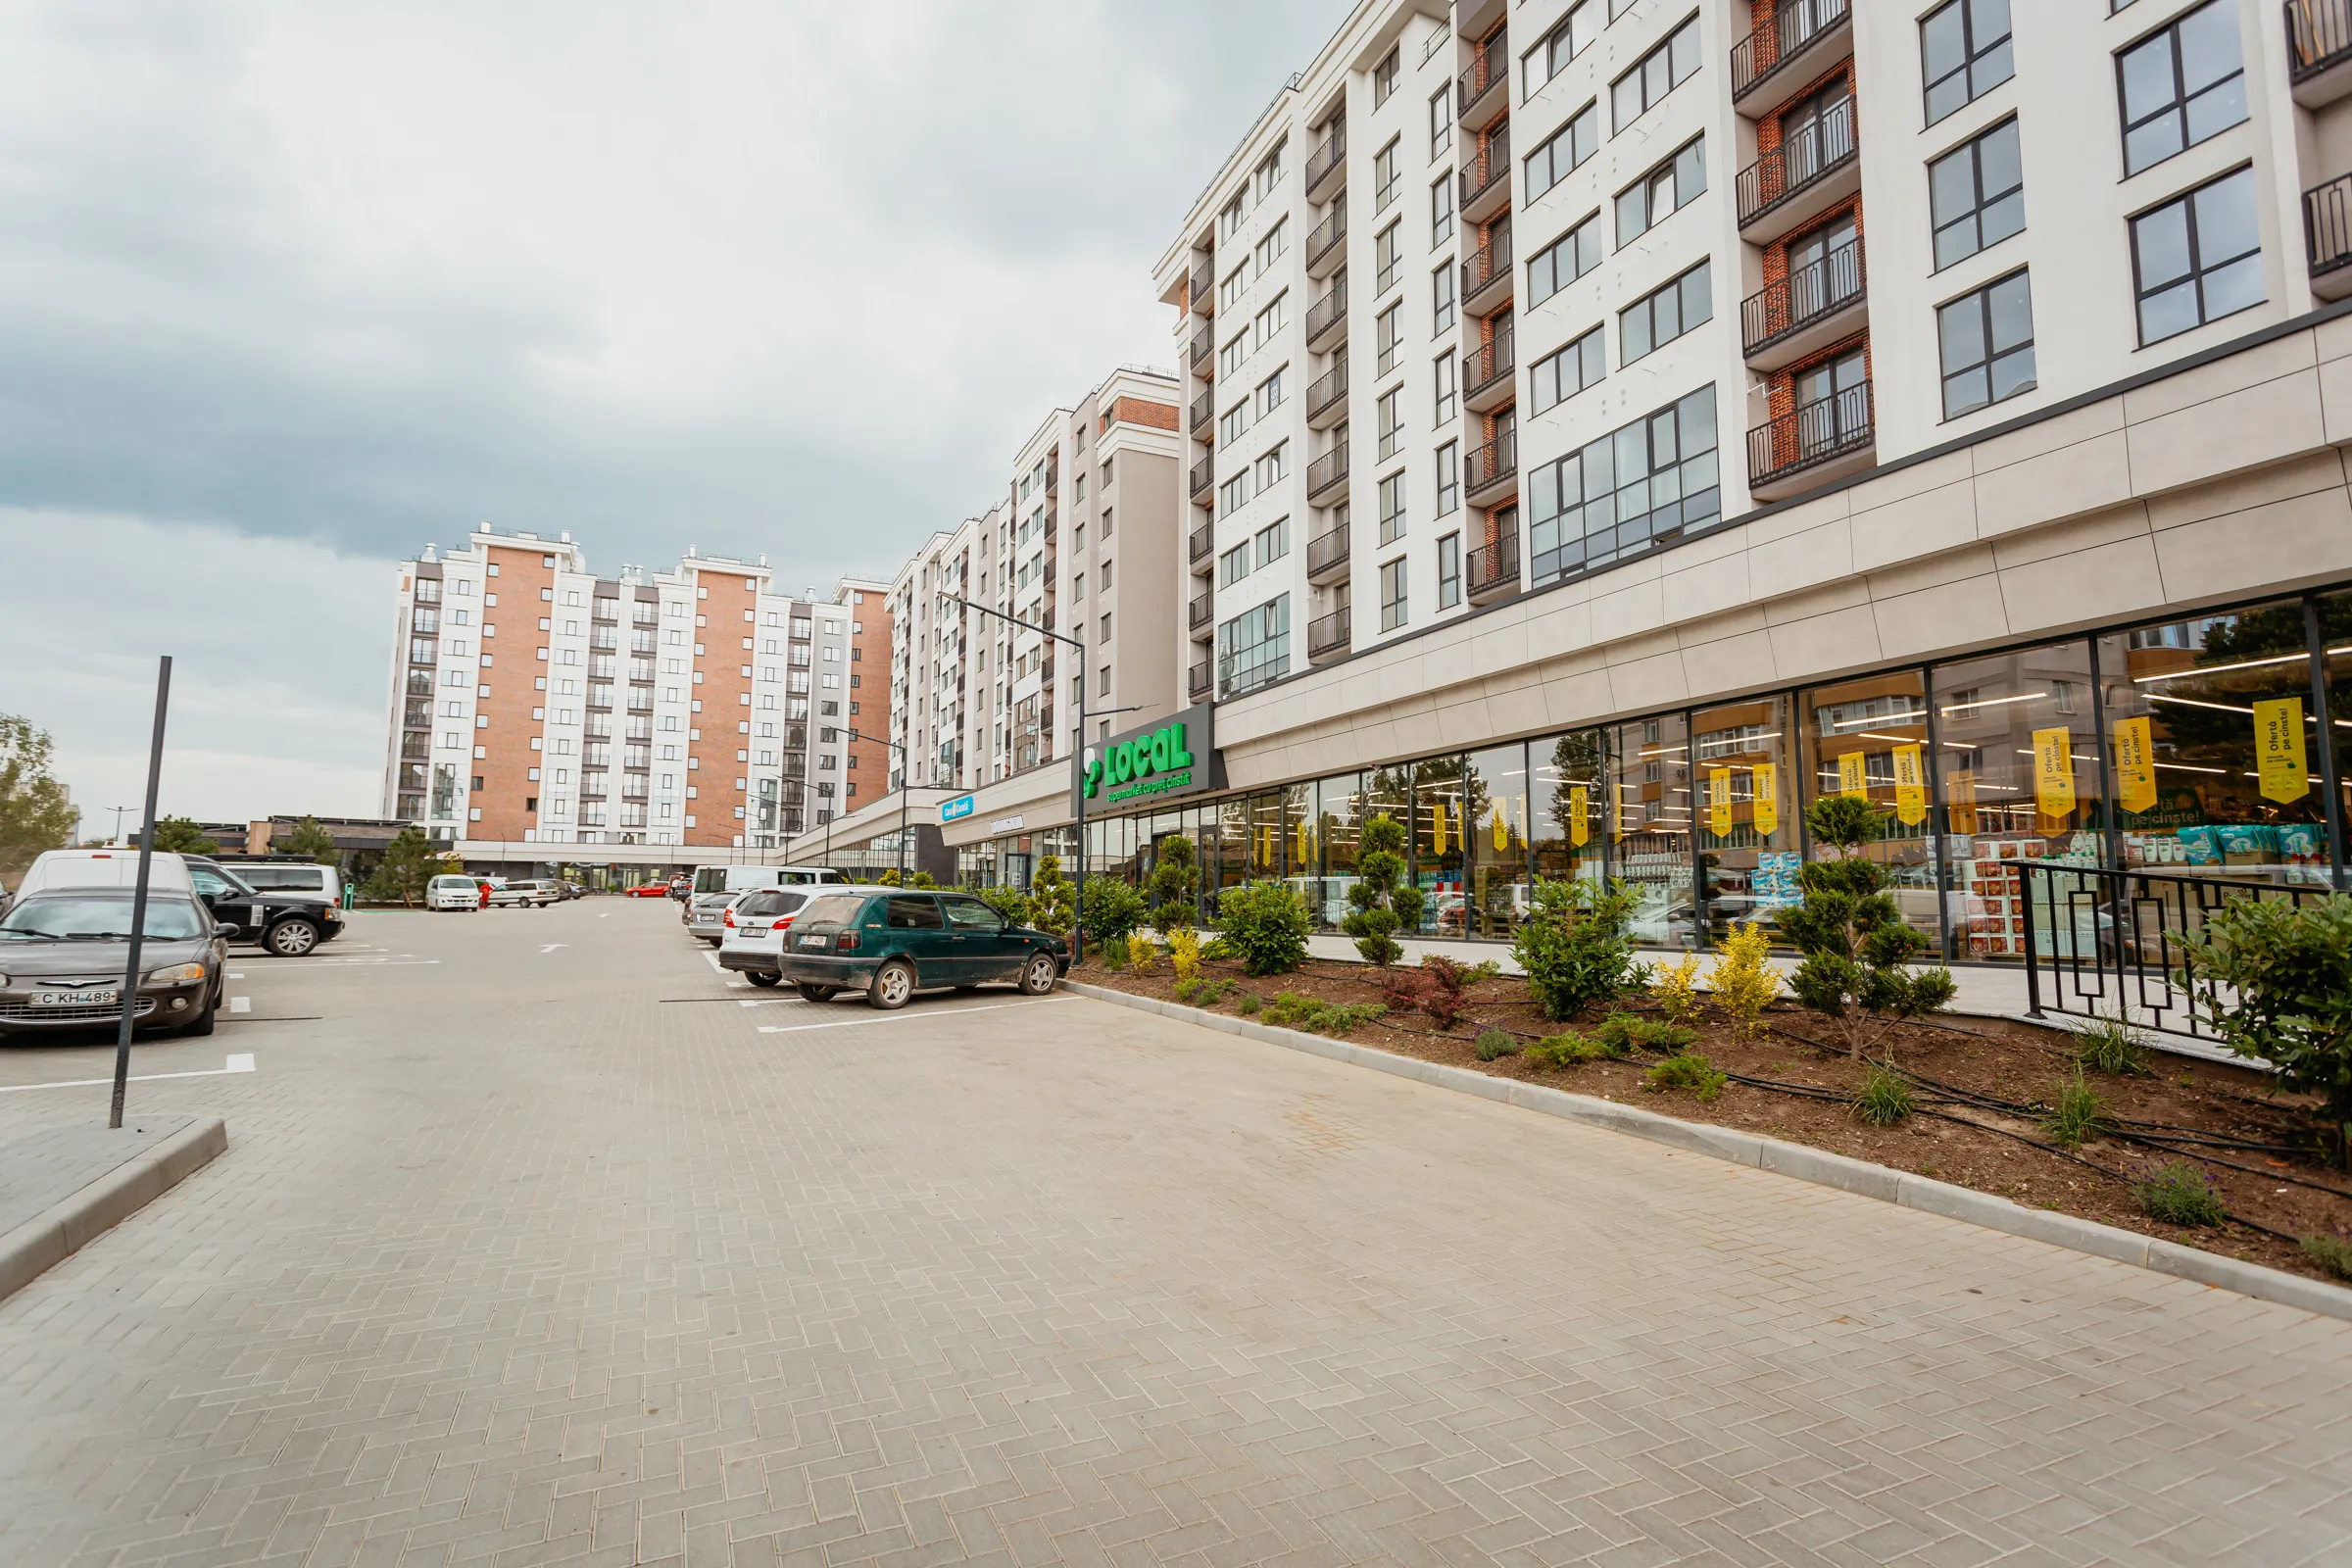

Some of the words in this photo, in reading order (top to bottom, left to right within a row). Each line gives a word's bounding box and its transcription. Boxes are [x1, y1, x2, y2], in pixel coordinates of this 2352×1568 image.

[2278, 708, 2289, 737] cinste!
[2052, 735, 2061, 759] cinste!
[2131, 726, 2140, 753] cinste!
[2267, 720, 2278, 752] Ofertă
[2282, 739, 2293, 751] pe
[2044, 747, 2053, 773] Ofertă
[2122, 738, 2132, 765] Ofertă
[2134, 754, 2142, 764] pe
[2055, 760, 2063, 772] pe
[2151, 809, 2200, 824] cinste!
[42, 994, 53, 1004] C
[59, 993, 78, 1004] KH
[84, 992, 111, 1003] 489
